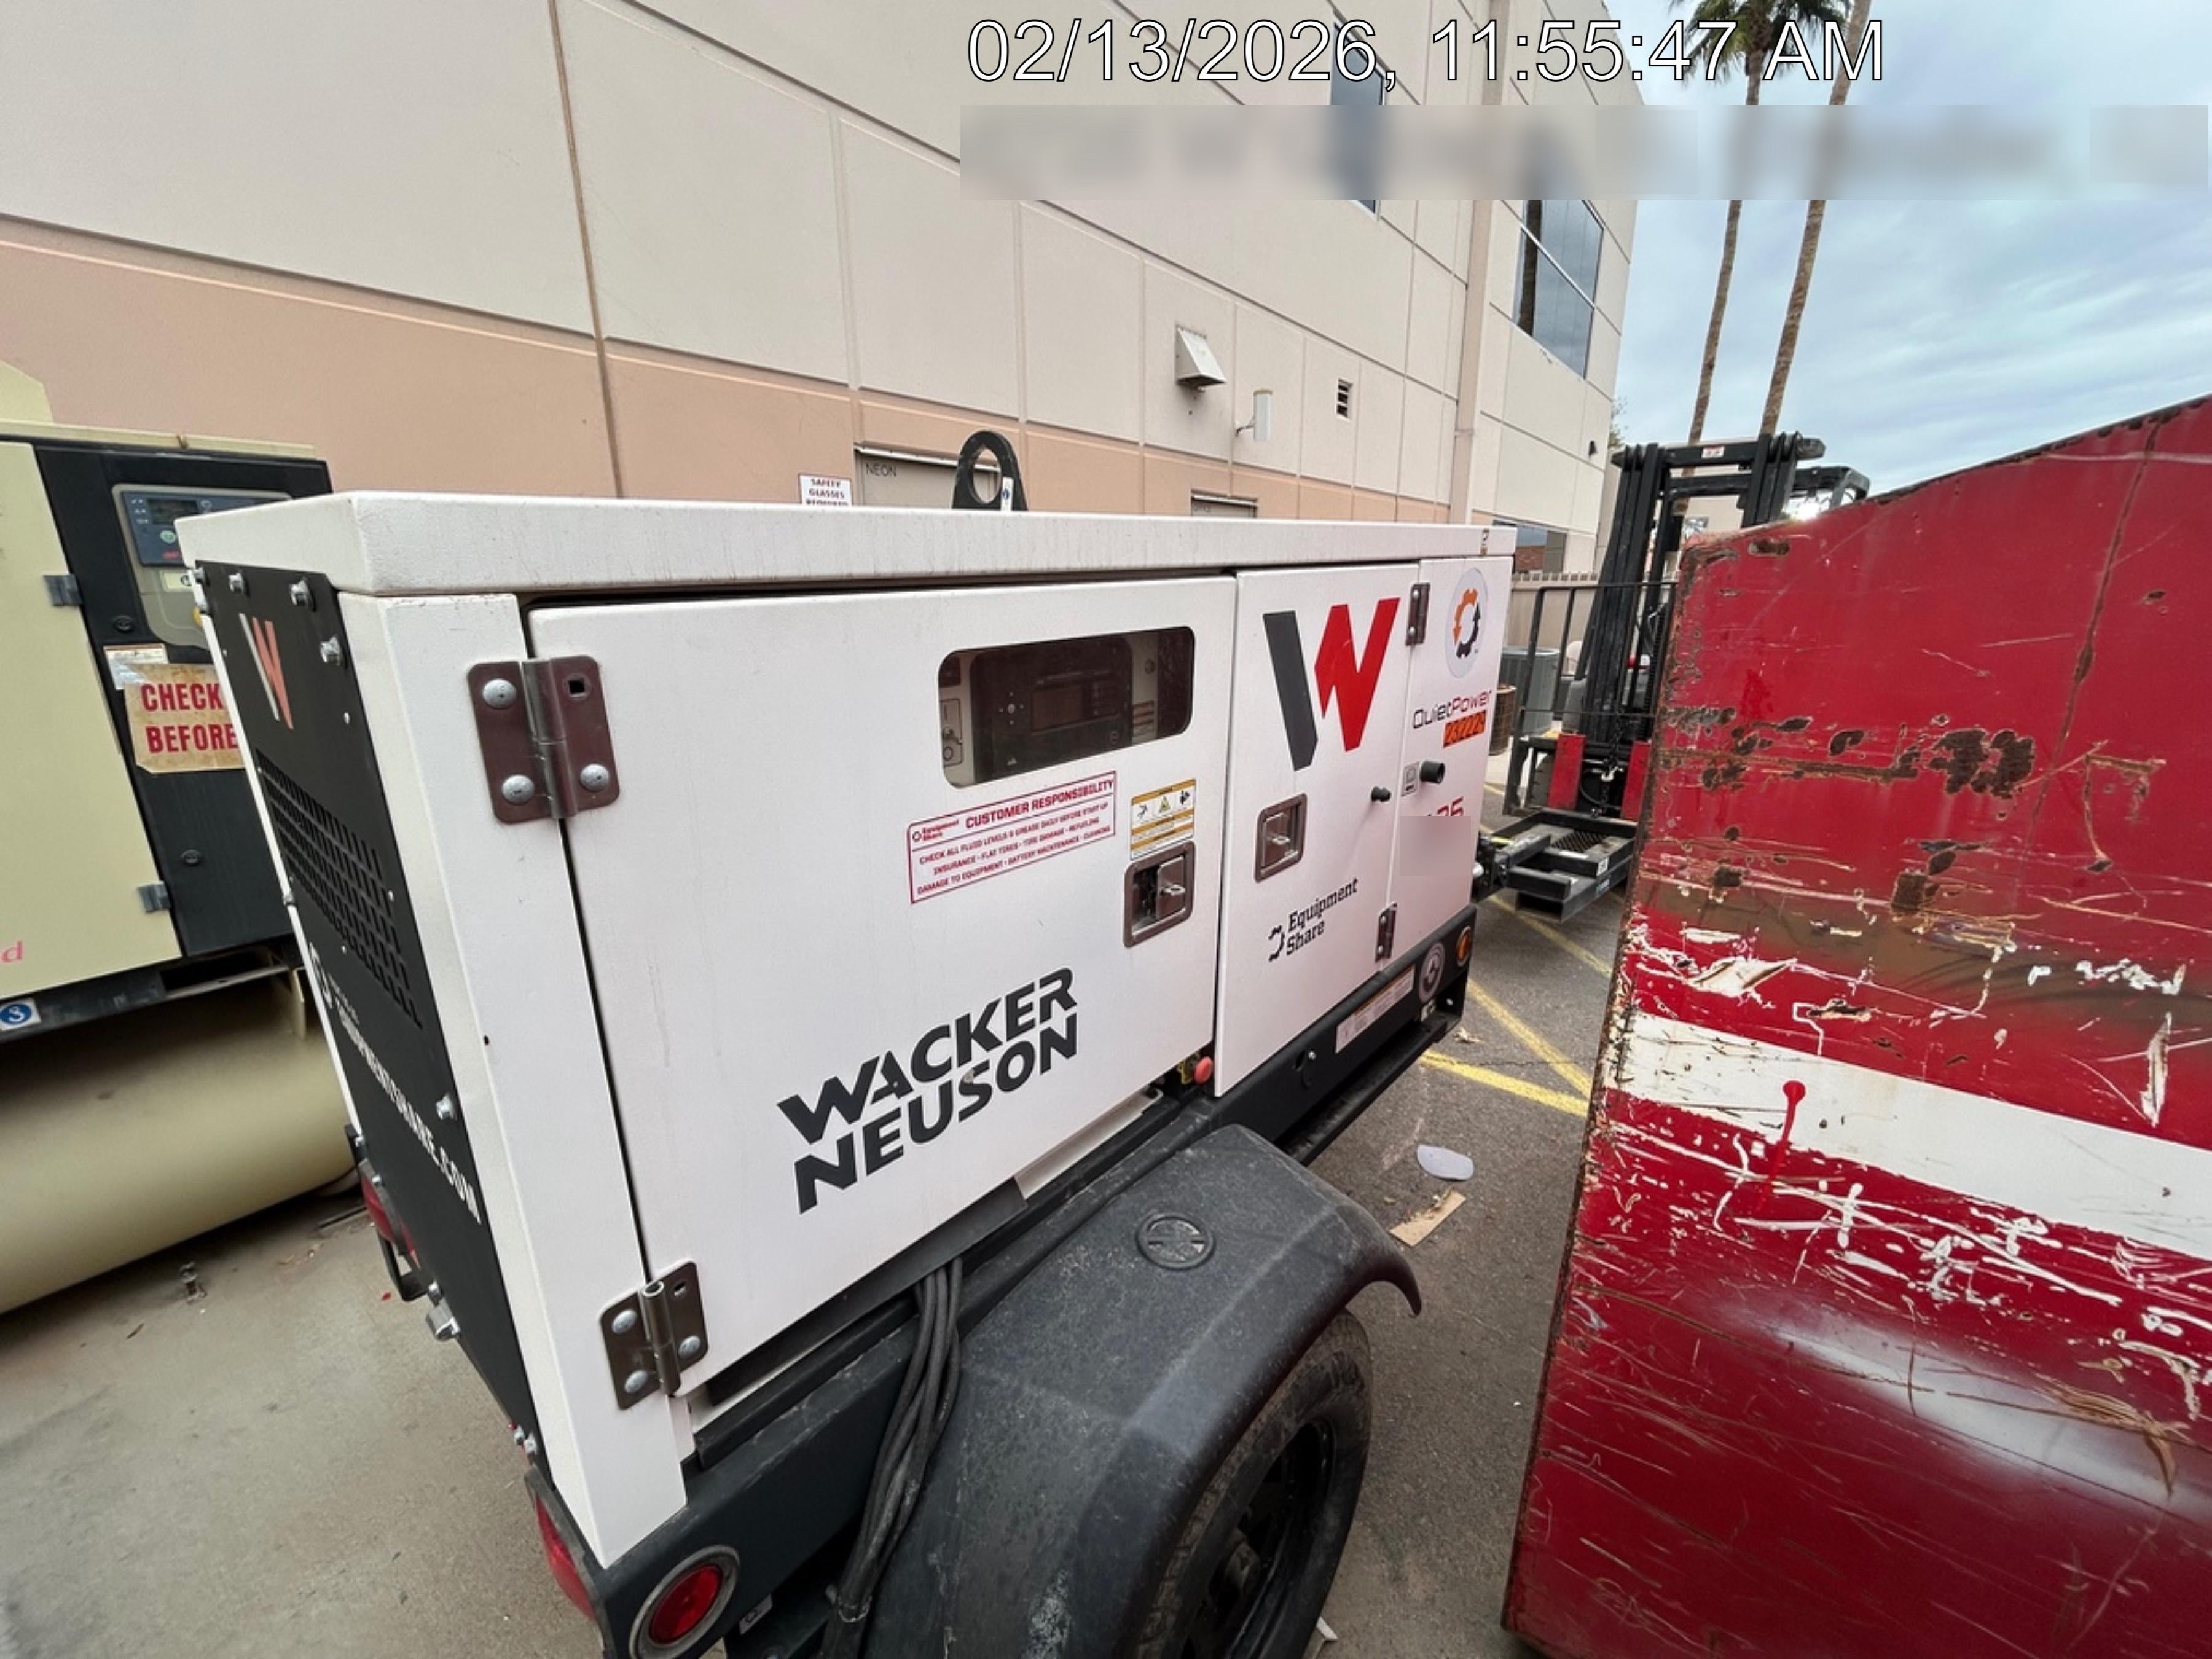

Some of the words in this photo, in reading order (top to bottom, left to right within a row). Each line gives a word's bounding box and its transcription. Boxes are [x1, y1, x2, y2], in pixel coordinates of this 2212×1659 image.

[811, 479, 841, 487] SAFETY
[866, 462, 896, 477] NEON
[809, 488, 845, 499] GLASSES
[141, 683, 224, 711] CHECK
[146, 723, 238, 753] BEFORE
[965, 801, 1029, 829] CUSTOMER
[1032, 779, 1113, 811] RESPONSIBILITY
[919, 850, 946, 865] CHECK
[947, 847, 960, 857] ALL
[933, 855, 976, 875] INSURANCE
[917, 877, 949, 895] DAMAGE
[951, 873, 961, 883] TO
[962, 860, 1004, 880] EQUIPMENT
[1288, 878, 1358, 933] Equipment
[1286, 920, 1325, 956] Share
[776, 967, 1078, 1145] WACKER
[793, 1012, 1078, 1215] NEUSON
